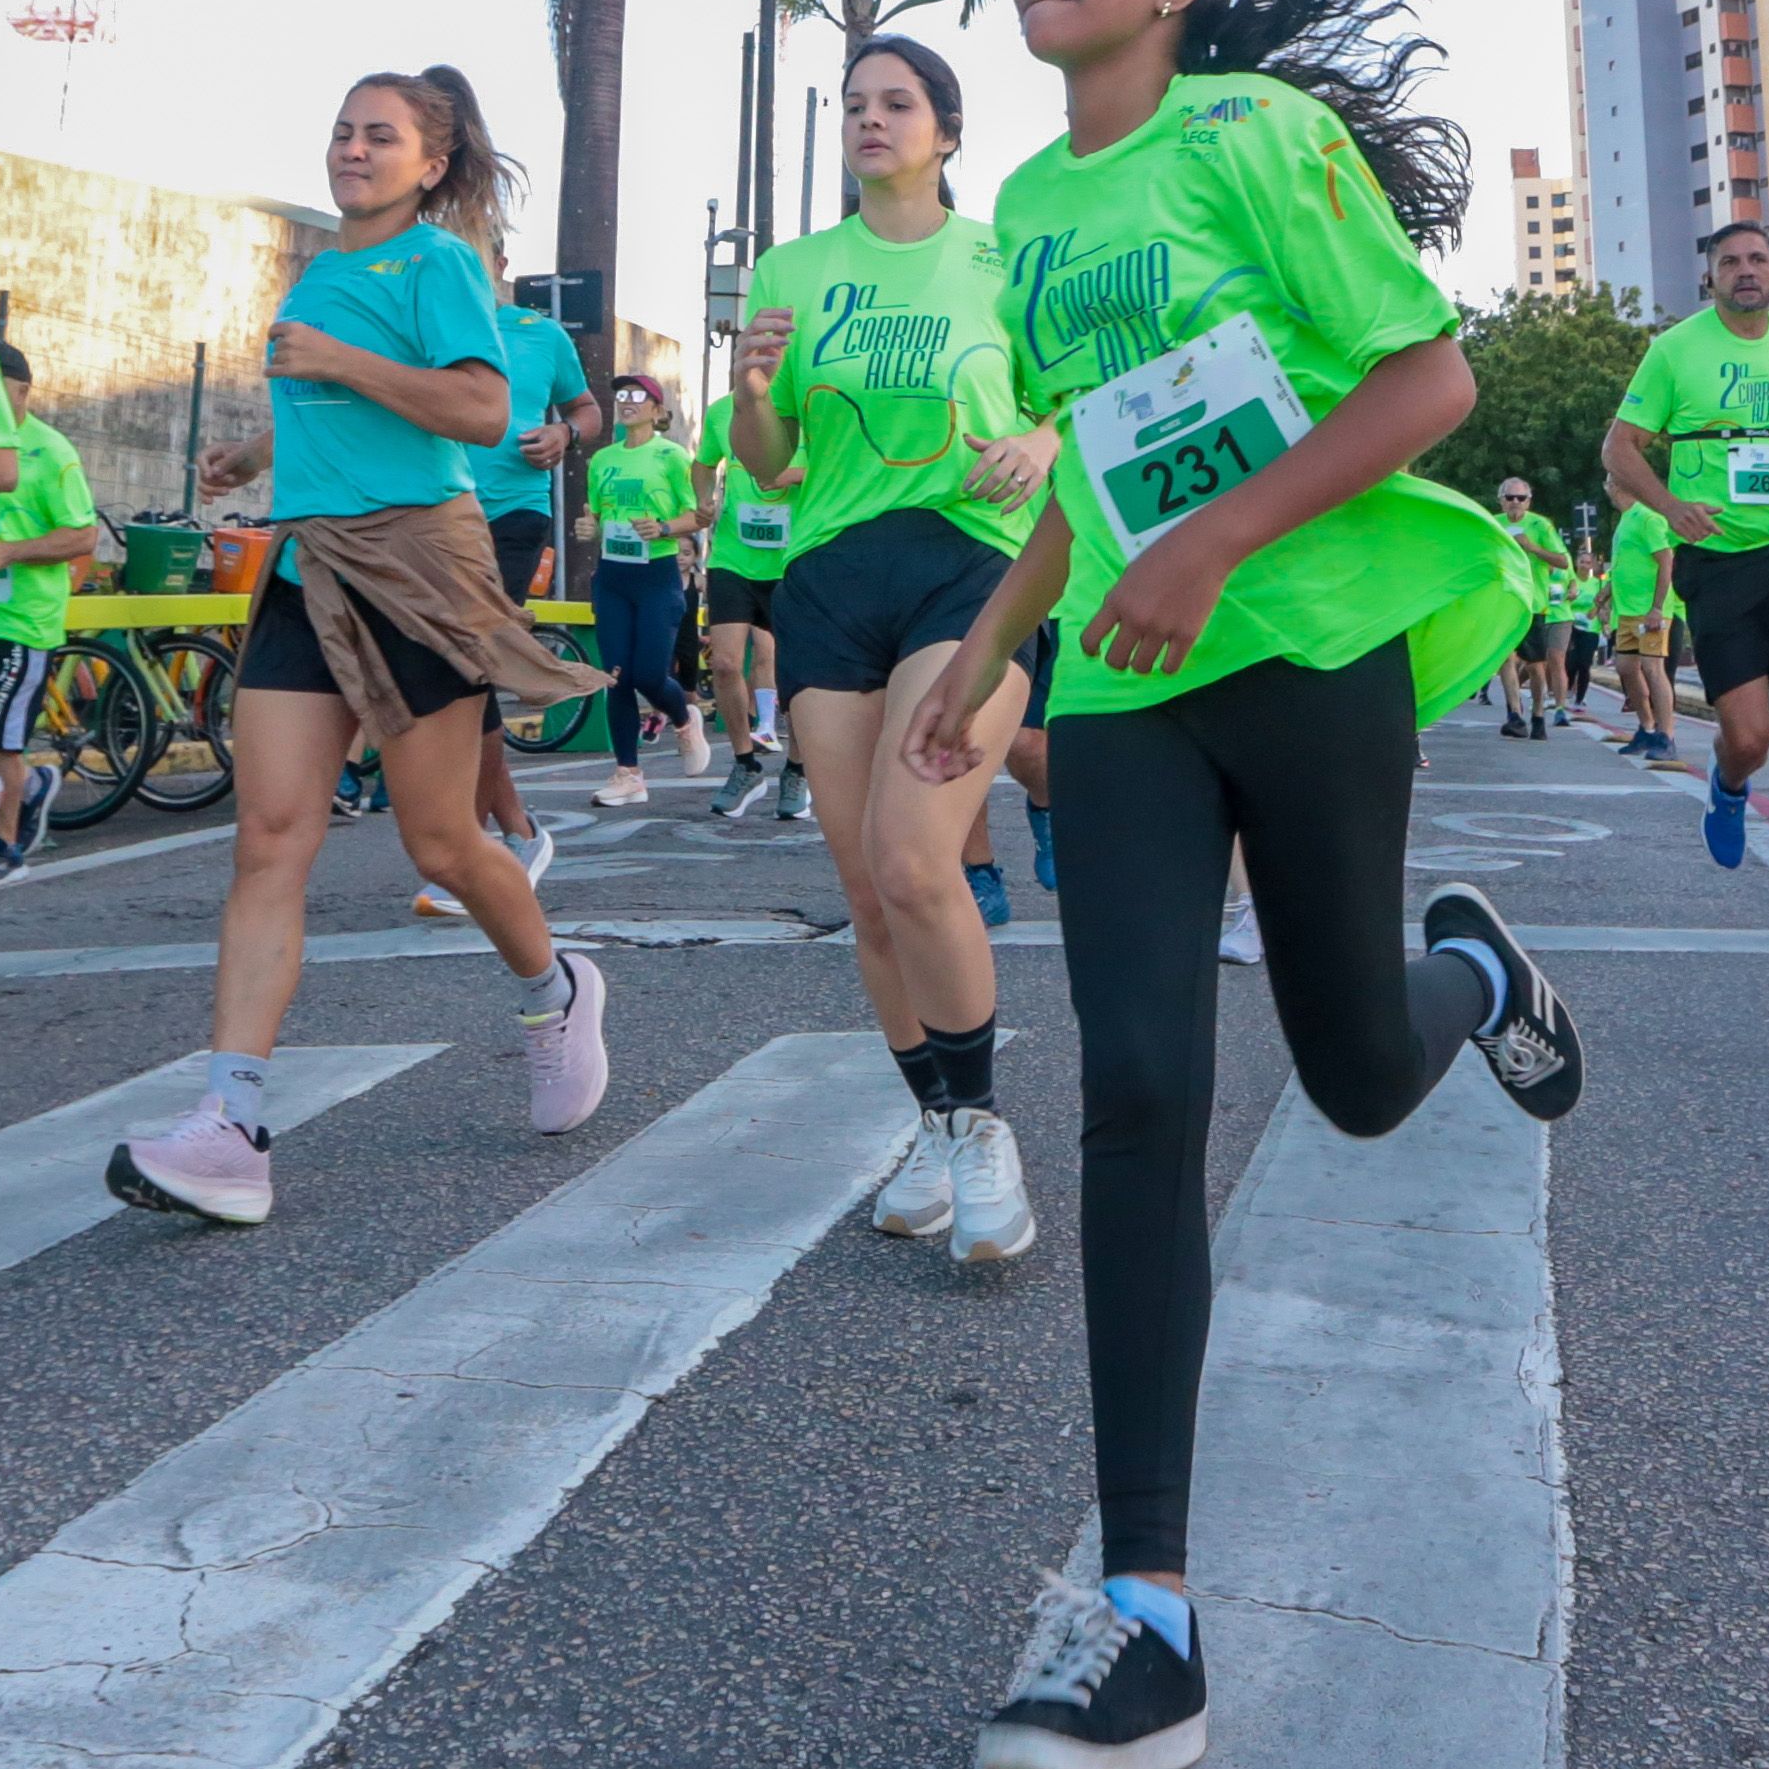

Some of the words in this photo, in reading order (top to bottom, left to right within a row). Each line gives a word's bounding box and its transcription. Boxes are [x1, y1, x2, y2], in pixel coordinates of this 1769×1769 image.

[1044, 241, 1170, 347] CORRIDA
[843, 315, 950, 354] CORRIDA
[864, 349, 942, 390] ALECE
[1142, 425, 1252, 515] 231
[612, 541, 636, 555] 988
[748, 526, 775, 540] 708
